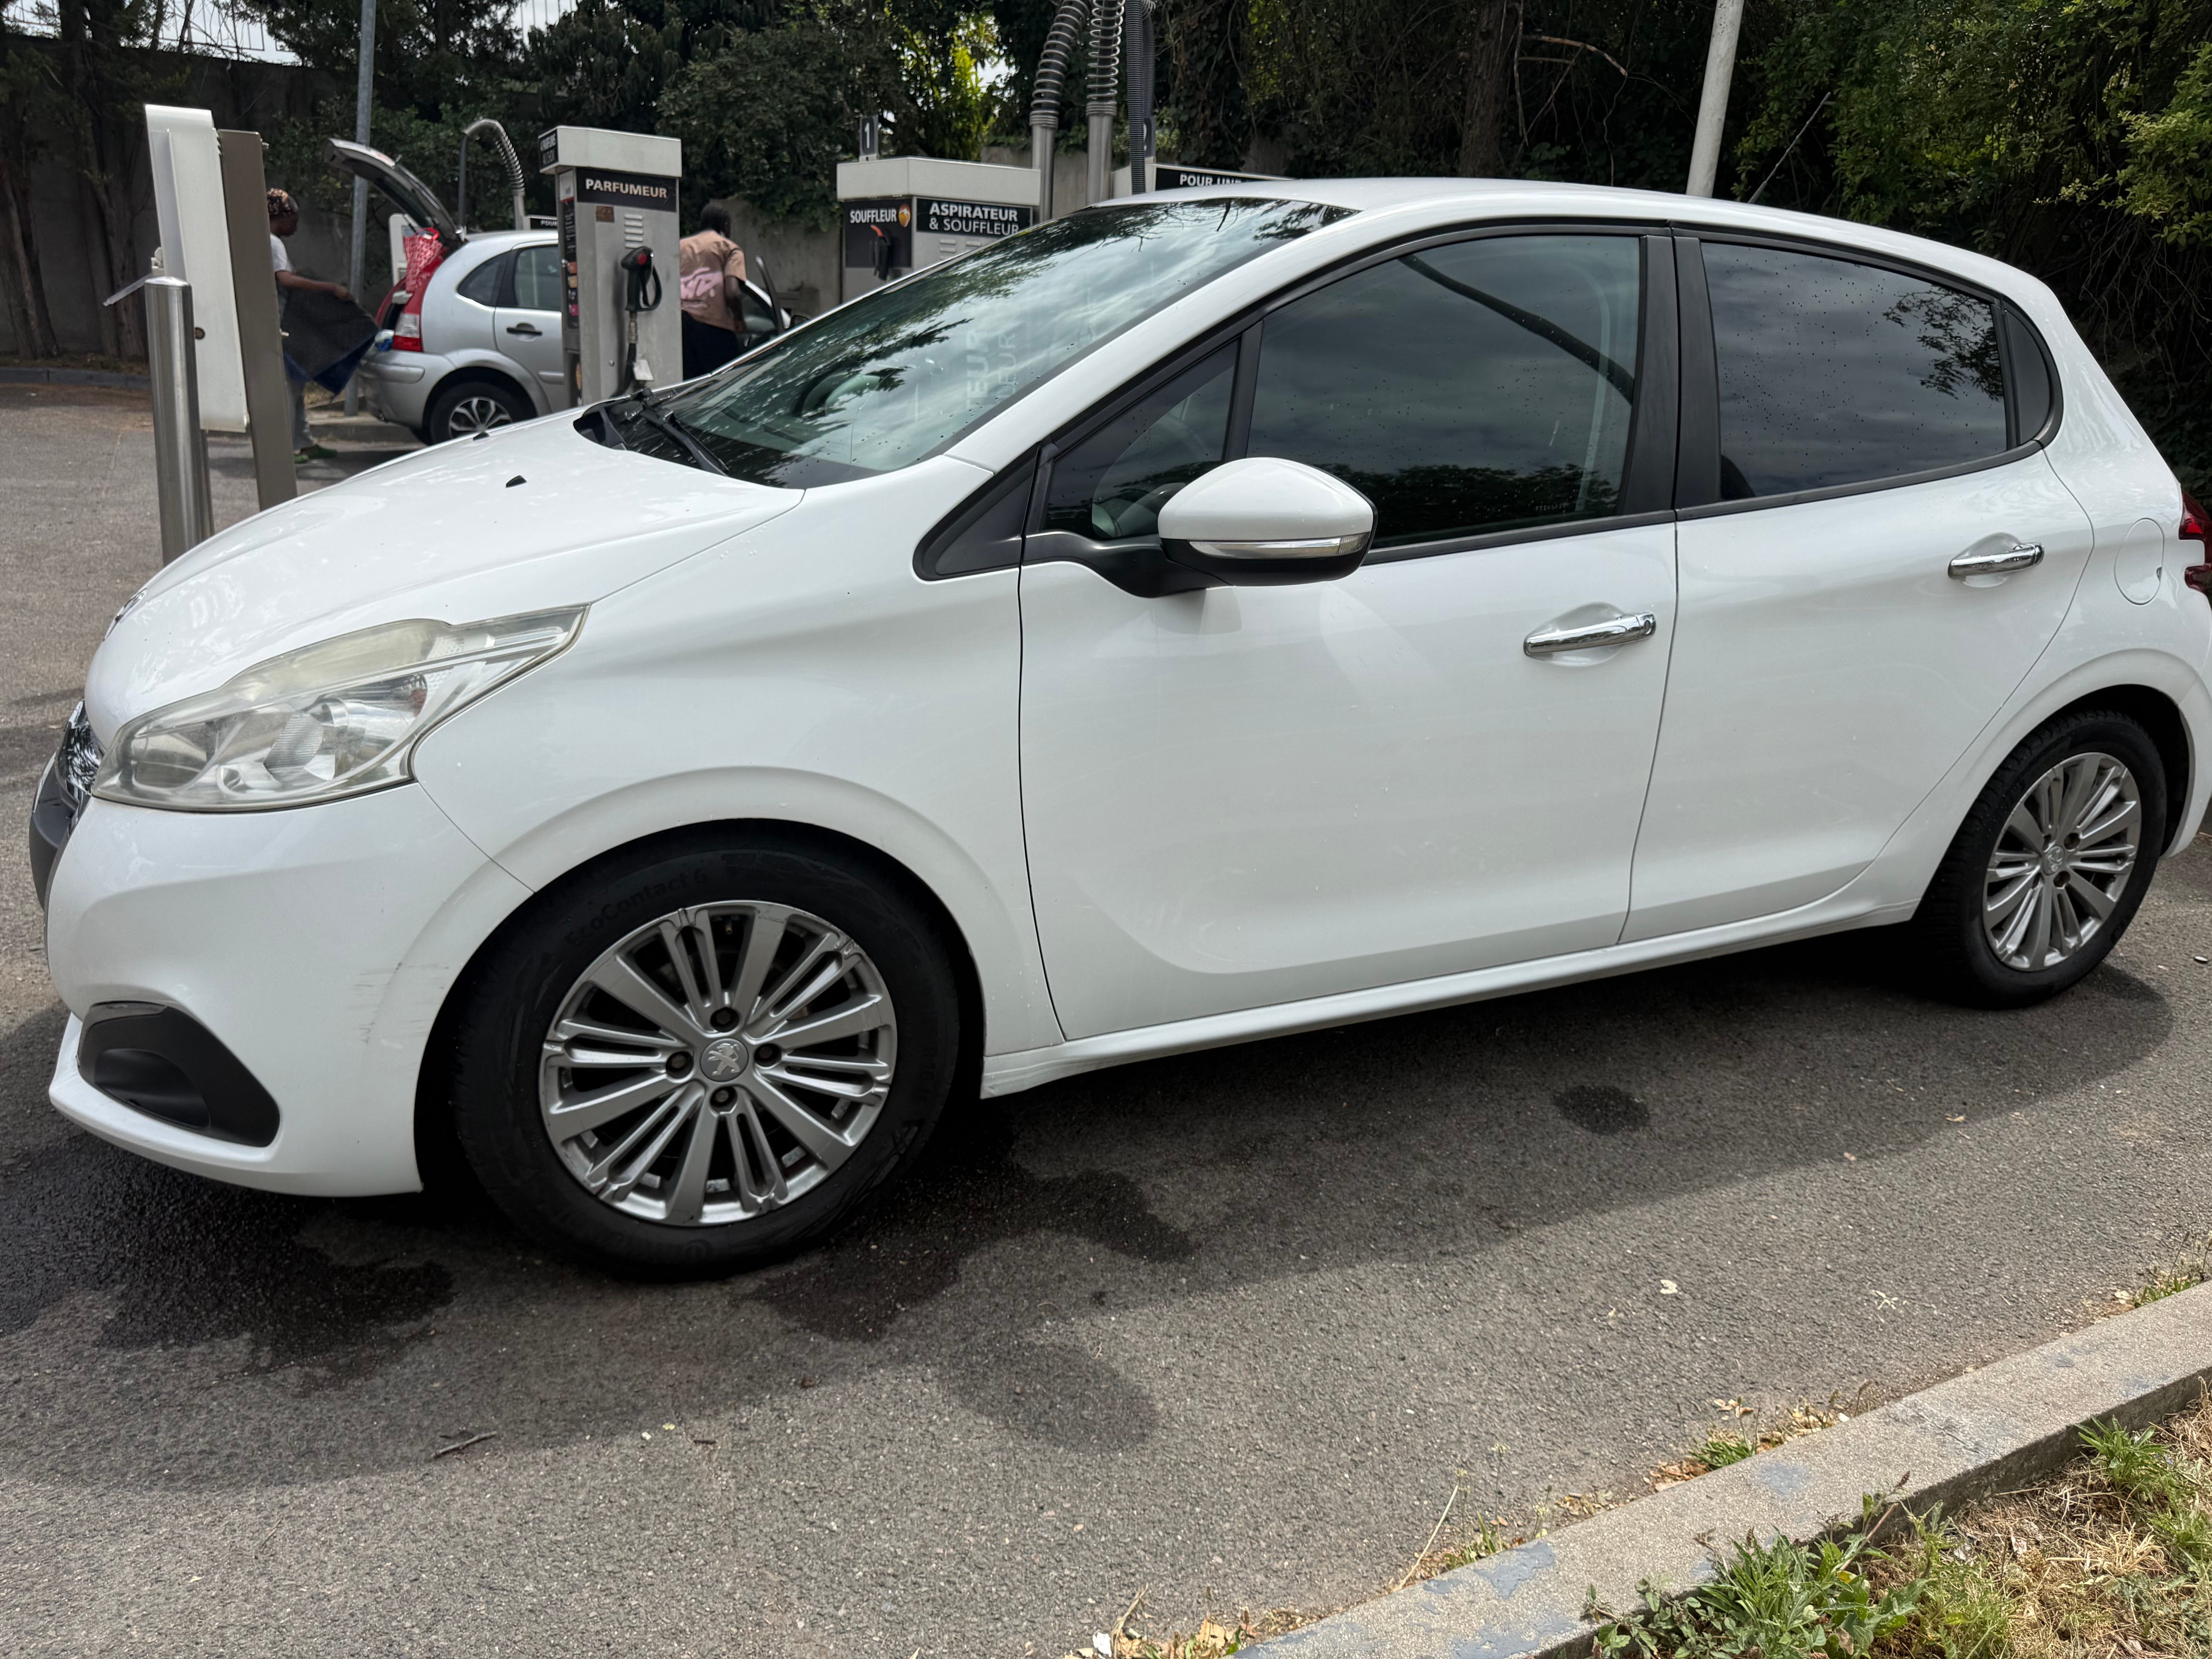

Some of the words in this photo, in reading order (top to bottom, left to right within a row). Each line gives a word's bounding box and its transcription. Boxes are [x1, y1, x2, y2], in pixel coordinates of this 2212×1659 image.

[864, 122, 870, 149] 1
[585, 178, 667, 198] PARFUMEUR
[1180, 174, 1212, 186] POUR
[849, 208, 897, 223] SOUFFLEUR
[929, 202, 1018, 222] ASPIRATEUR
[929, 218, 938, 230] &
[943, 218, 1019, 235] SOUFFLEUR
[564, 872, 689, 945] EcoContact
